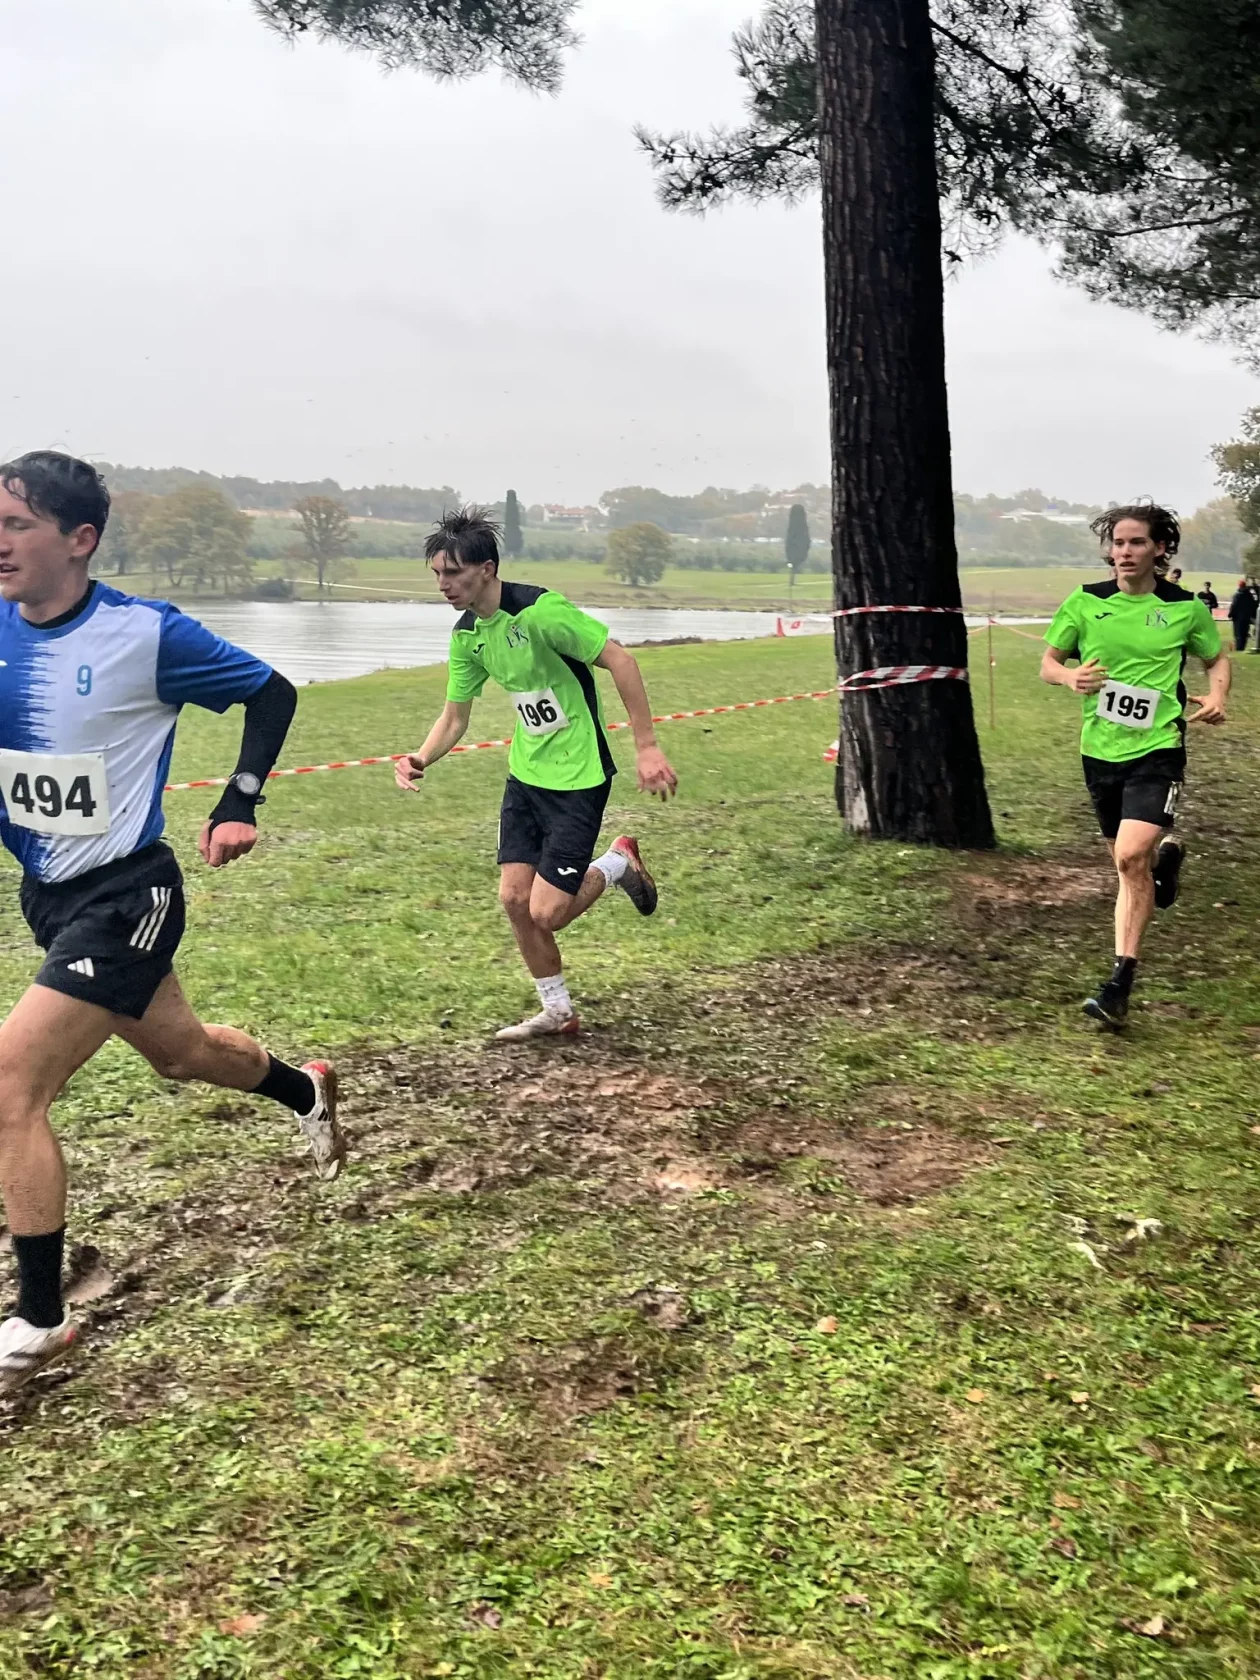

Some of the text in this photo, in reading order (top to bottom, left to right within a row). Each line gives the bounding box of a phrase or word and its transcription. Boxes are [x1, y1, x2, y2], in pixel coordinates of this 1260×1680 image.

[76, 664, 92, 696] 9
[517, 698, 557, 727] 196
[1105, 691, 1150, 720] 195
[11, 773, 97, 817] 494
